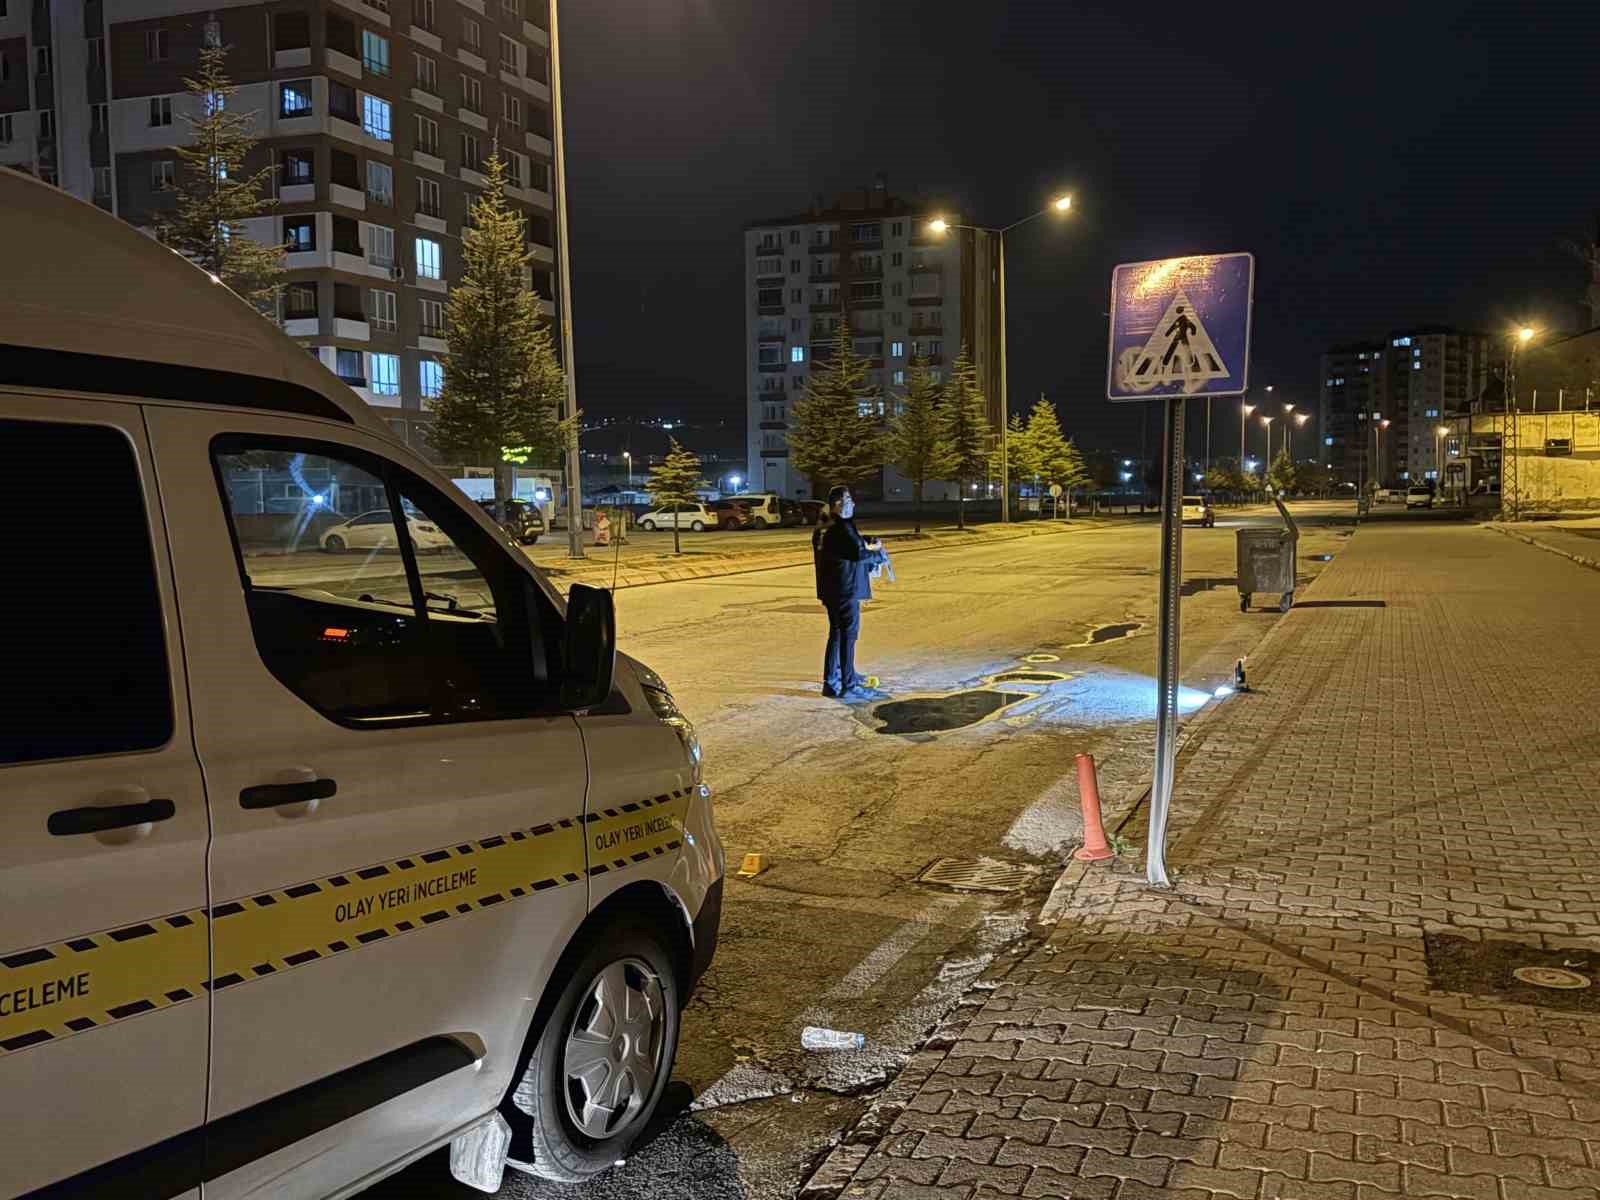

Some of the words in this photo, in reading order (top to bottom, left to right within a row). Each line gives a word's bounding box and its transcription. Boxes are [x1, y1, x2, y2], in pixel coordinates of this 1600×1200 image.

[595, 829, 621, 850] OLAY
[335, 896, 374, 922] OLAY
[379, 886, 410, 910] YERİ
[414, 868, 477, 900] İNCELEME
[0, 972, 90, 1016] CELEME
